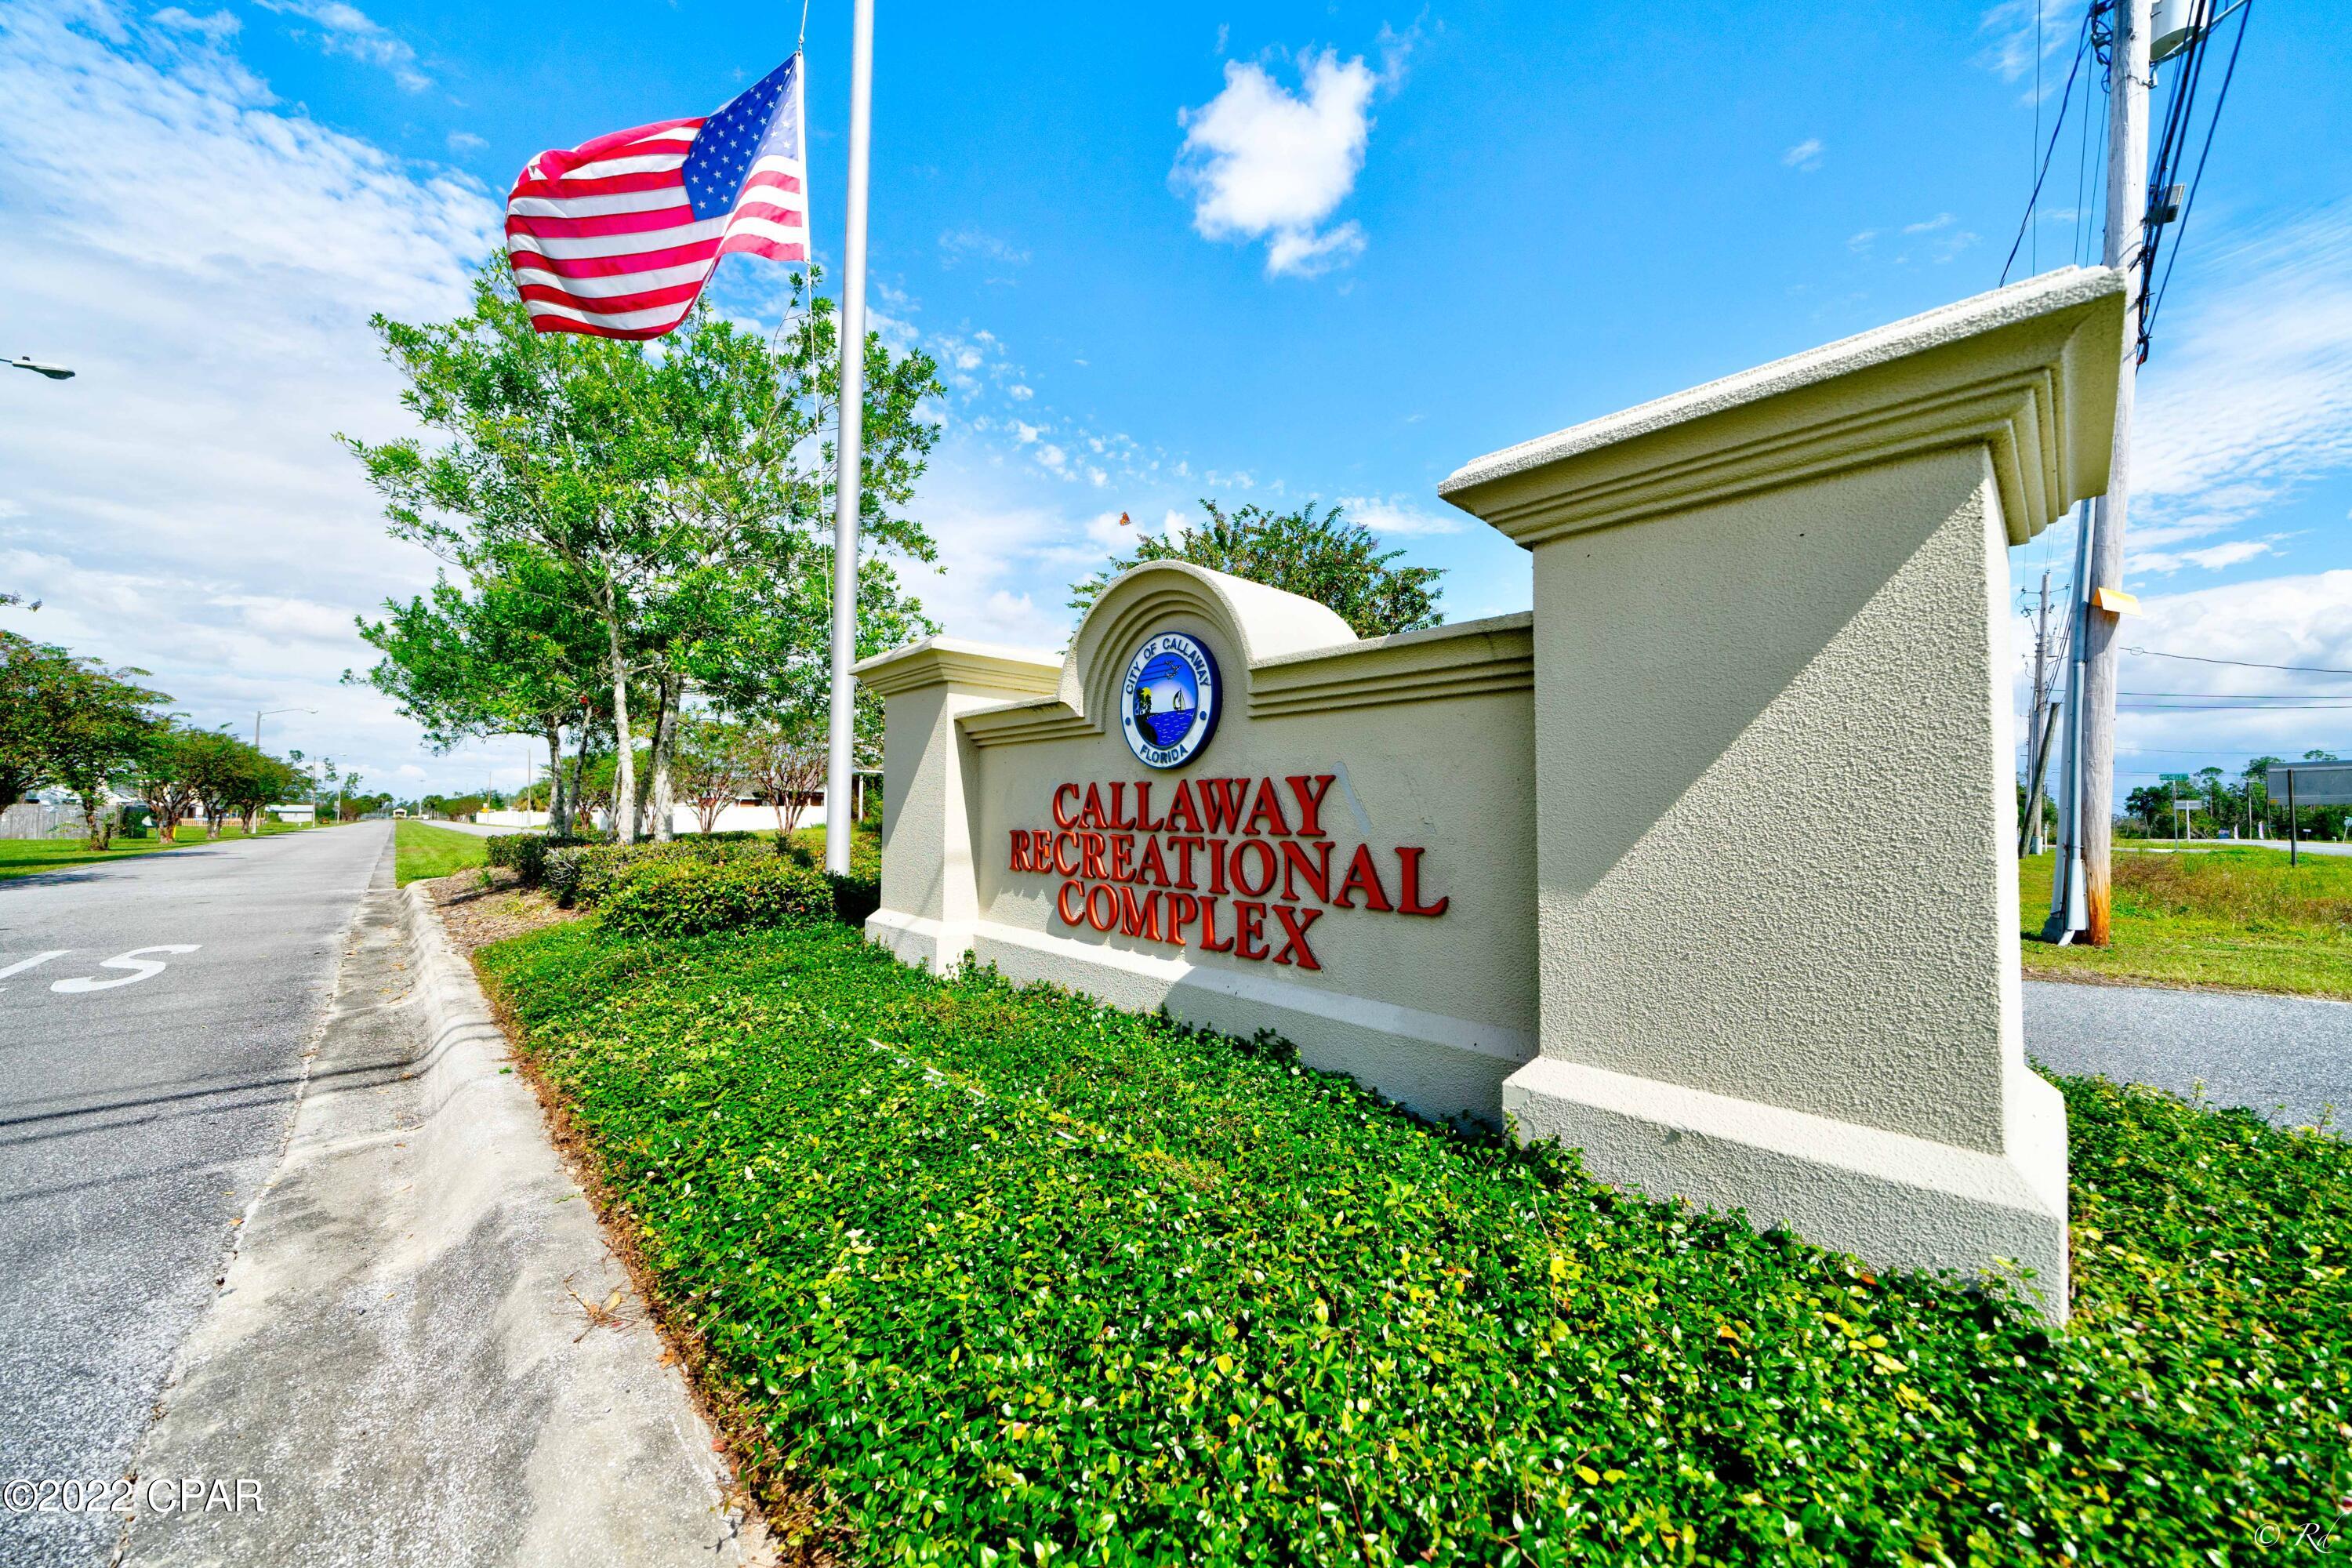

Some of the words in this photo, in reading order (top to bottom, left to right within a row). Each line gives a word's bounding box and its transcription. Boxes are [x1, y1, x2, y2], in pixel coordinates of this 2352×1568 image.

[1125, 662, 1142, 695] CITY
[1143, 642, 1157, 660] OF
[1163, 637, 1210, 687] CALLAWAY
[1139, 744, 1189, 764] FLORIDA
[1052, 775, 1336, 837] CALLAWAY
[1010, 829, 1449, 916] RECREATIONAL
[1058, 879, 1323, 970] COMPLEX
